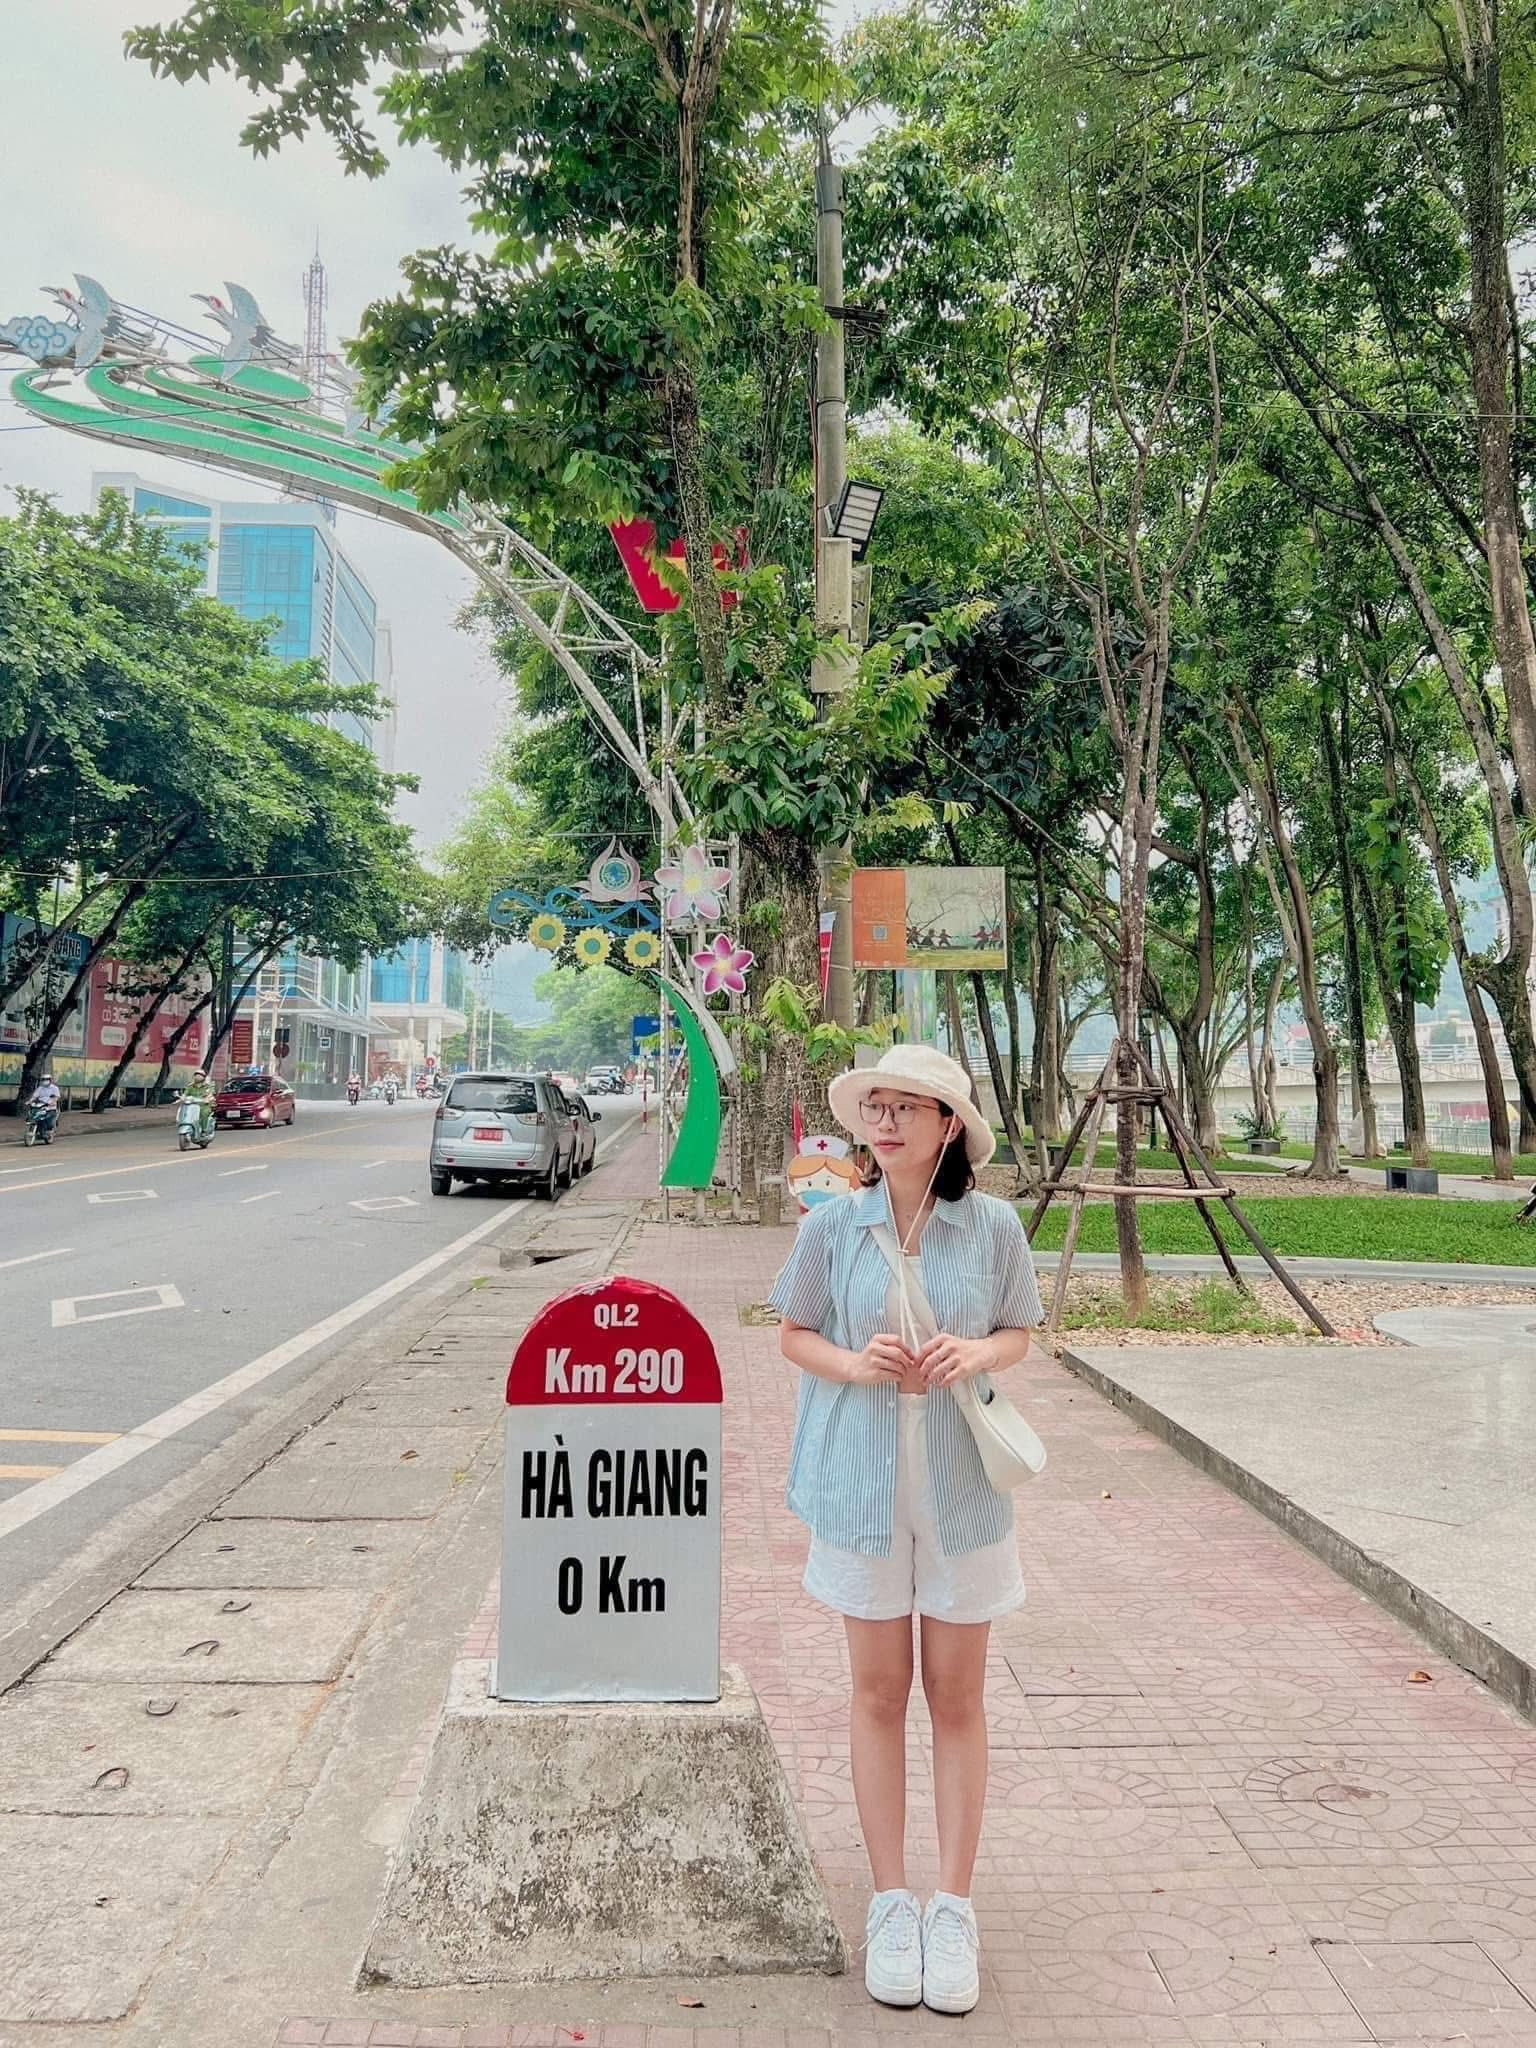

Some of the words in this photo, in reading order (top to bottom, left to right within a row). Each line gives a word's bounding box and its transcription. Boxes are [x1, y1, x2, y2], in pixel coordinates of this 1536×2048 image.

[594, 1304, 639, 1329] QL2
[545, 1348, 606, 1394] Km
[613, 1348, 684, 1394] 290
[521, 1434, 574, 1519] HÀ
[587, 1447, 708, 1519] GIANG
[558, 1556, 583, 1615] 0
[599, 1555, 666, 1614] Km
